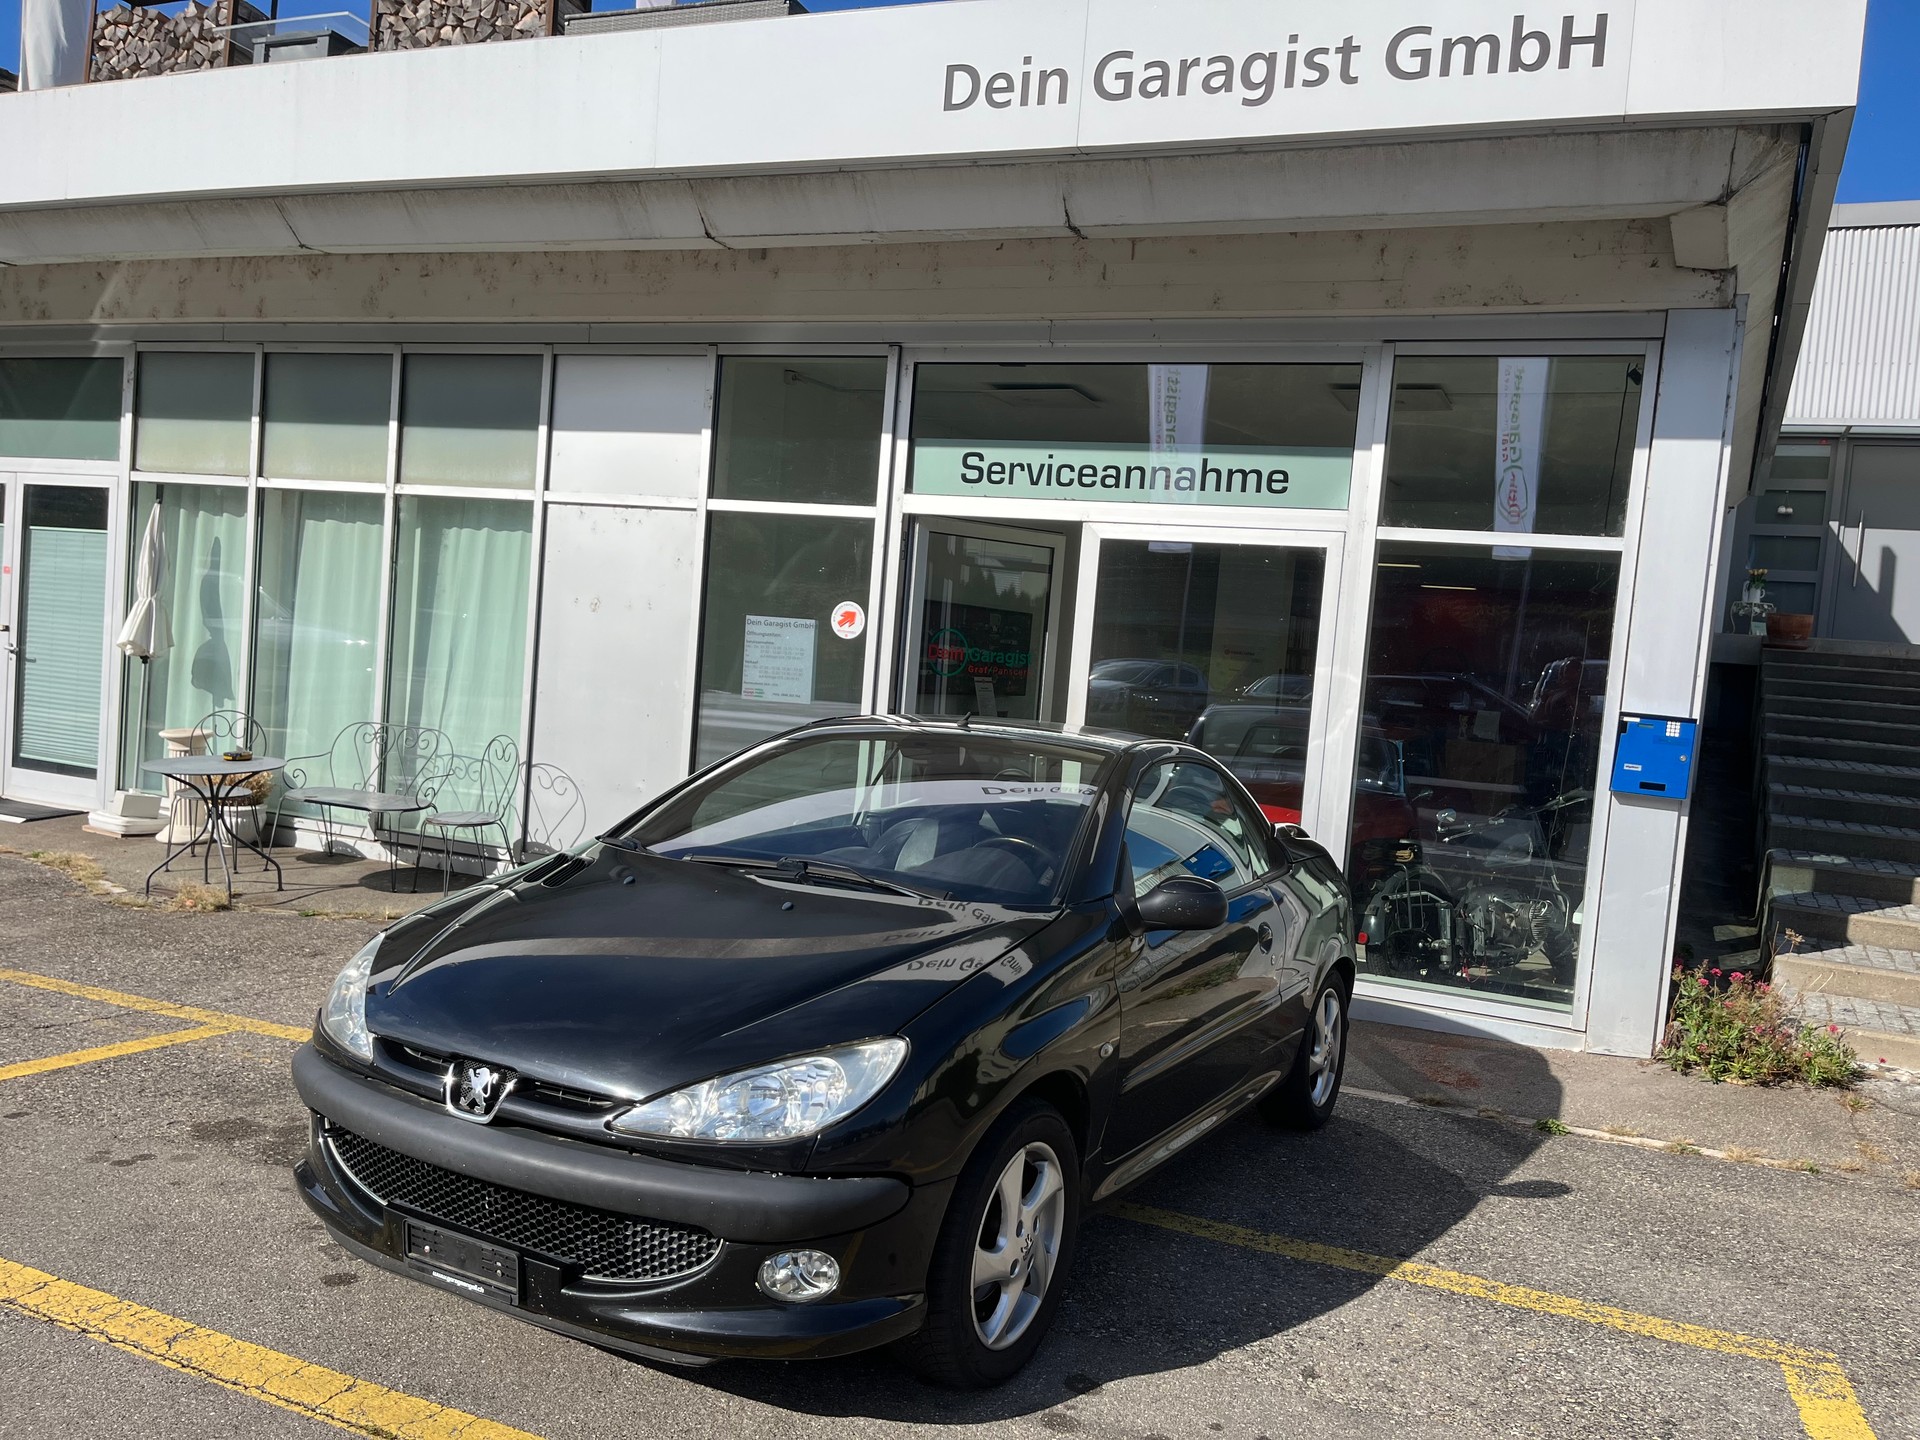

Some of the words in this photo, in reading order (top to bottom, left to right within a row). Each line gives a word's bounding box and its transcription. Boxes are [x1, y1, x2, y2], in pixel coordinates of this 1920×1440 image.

[943, 56, 1070, 112] Dein
[1091, 34, 1361, 107] Garagist
[1384, 13, 1609, 81] GmbH
[960, 451, 1290, 494] Serviceannahme
[746, 618, 762, 626] Dein
[763, 619, 792, 629] Garagist
[793, 621, 815, 629] GmbH
[928, 643, 965, 661] Dein
[968, 647, 1033, 668] Garagist
